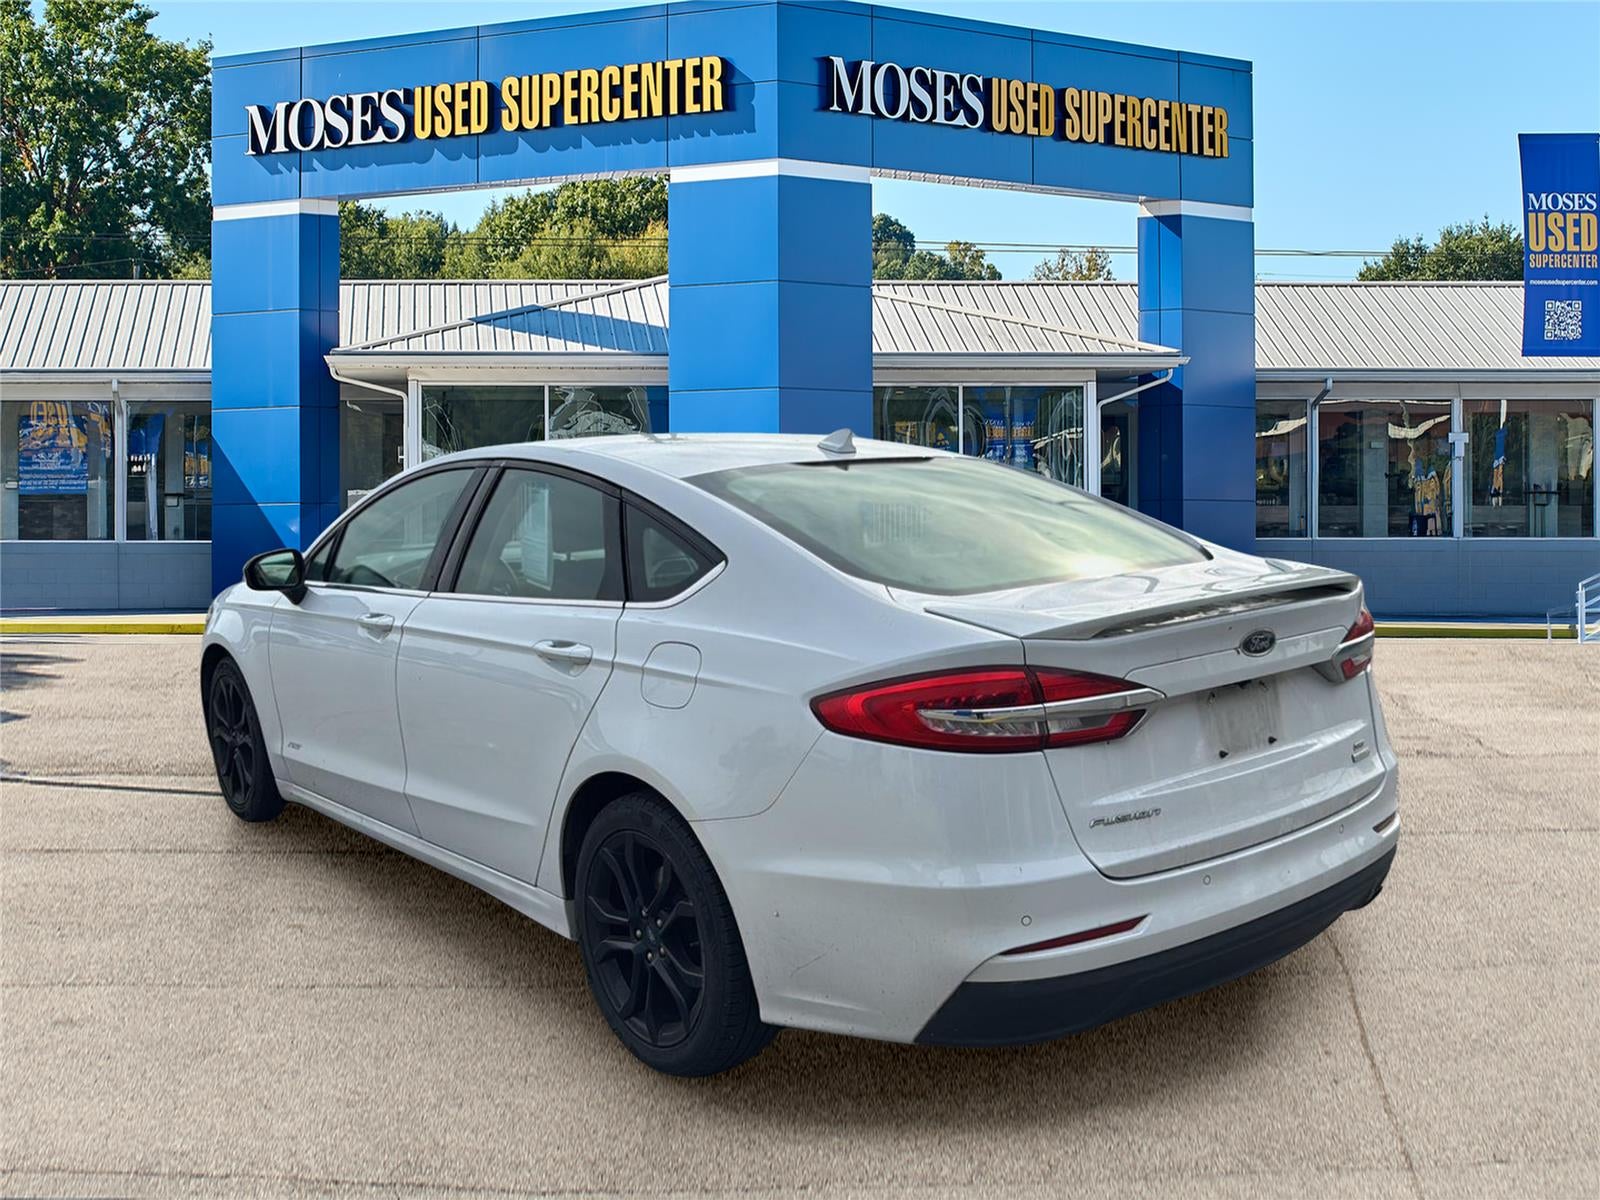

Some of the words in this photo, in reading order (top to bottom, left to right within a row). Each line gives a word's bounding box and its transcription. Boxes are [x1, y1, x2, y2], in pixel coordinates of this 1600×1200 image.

[244, 88, 407, 156] MOSES
[413, 80, 489, 140] USED
[500, 55, 724, 132] SUPERCENTER
[828, 55, 985, 129] MOSES
[991, 77, 1055, 137] USED
[1065, 87, 1230, 158] SUPERCENTER
[1528, 192, 1597, 211] MOSES
[1528, 212, 1598, 252] USED
[1529, 253, 1598, 269] SUPERCENTER
